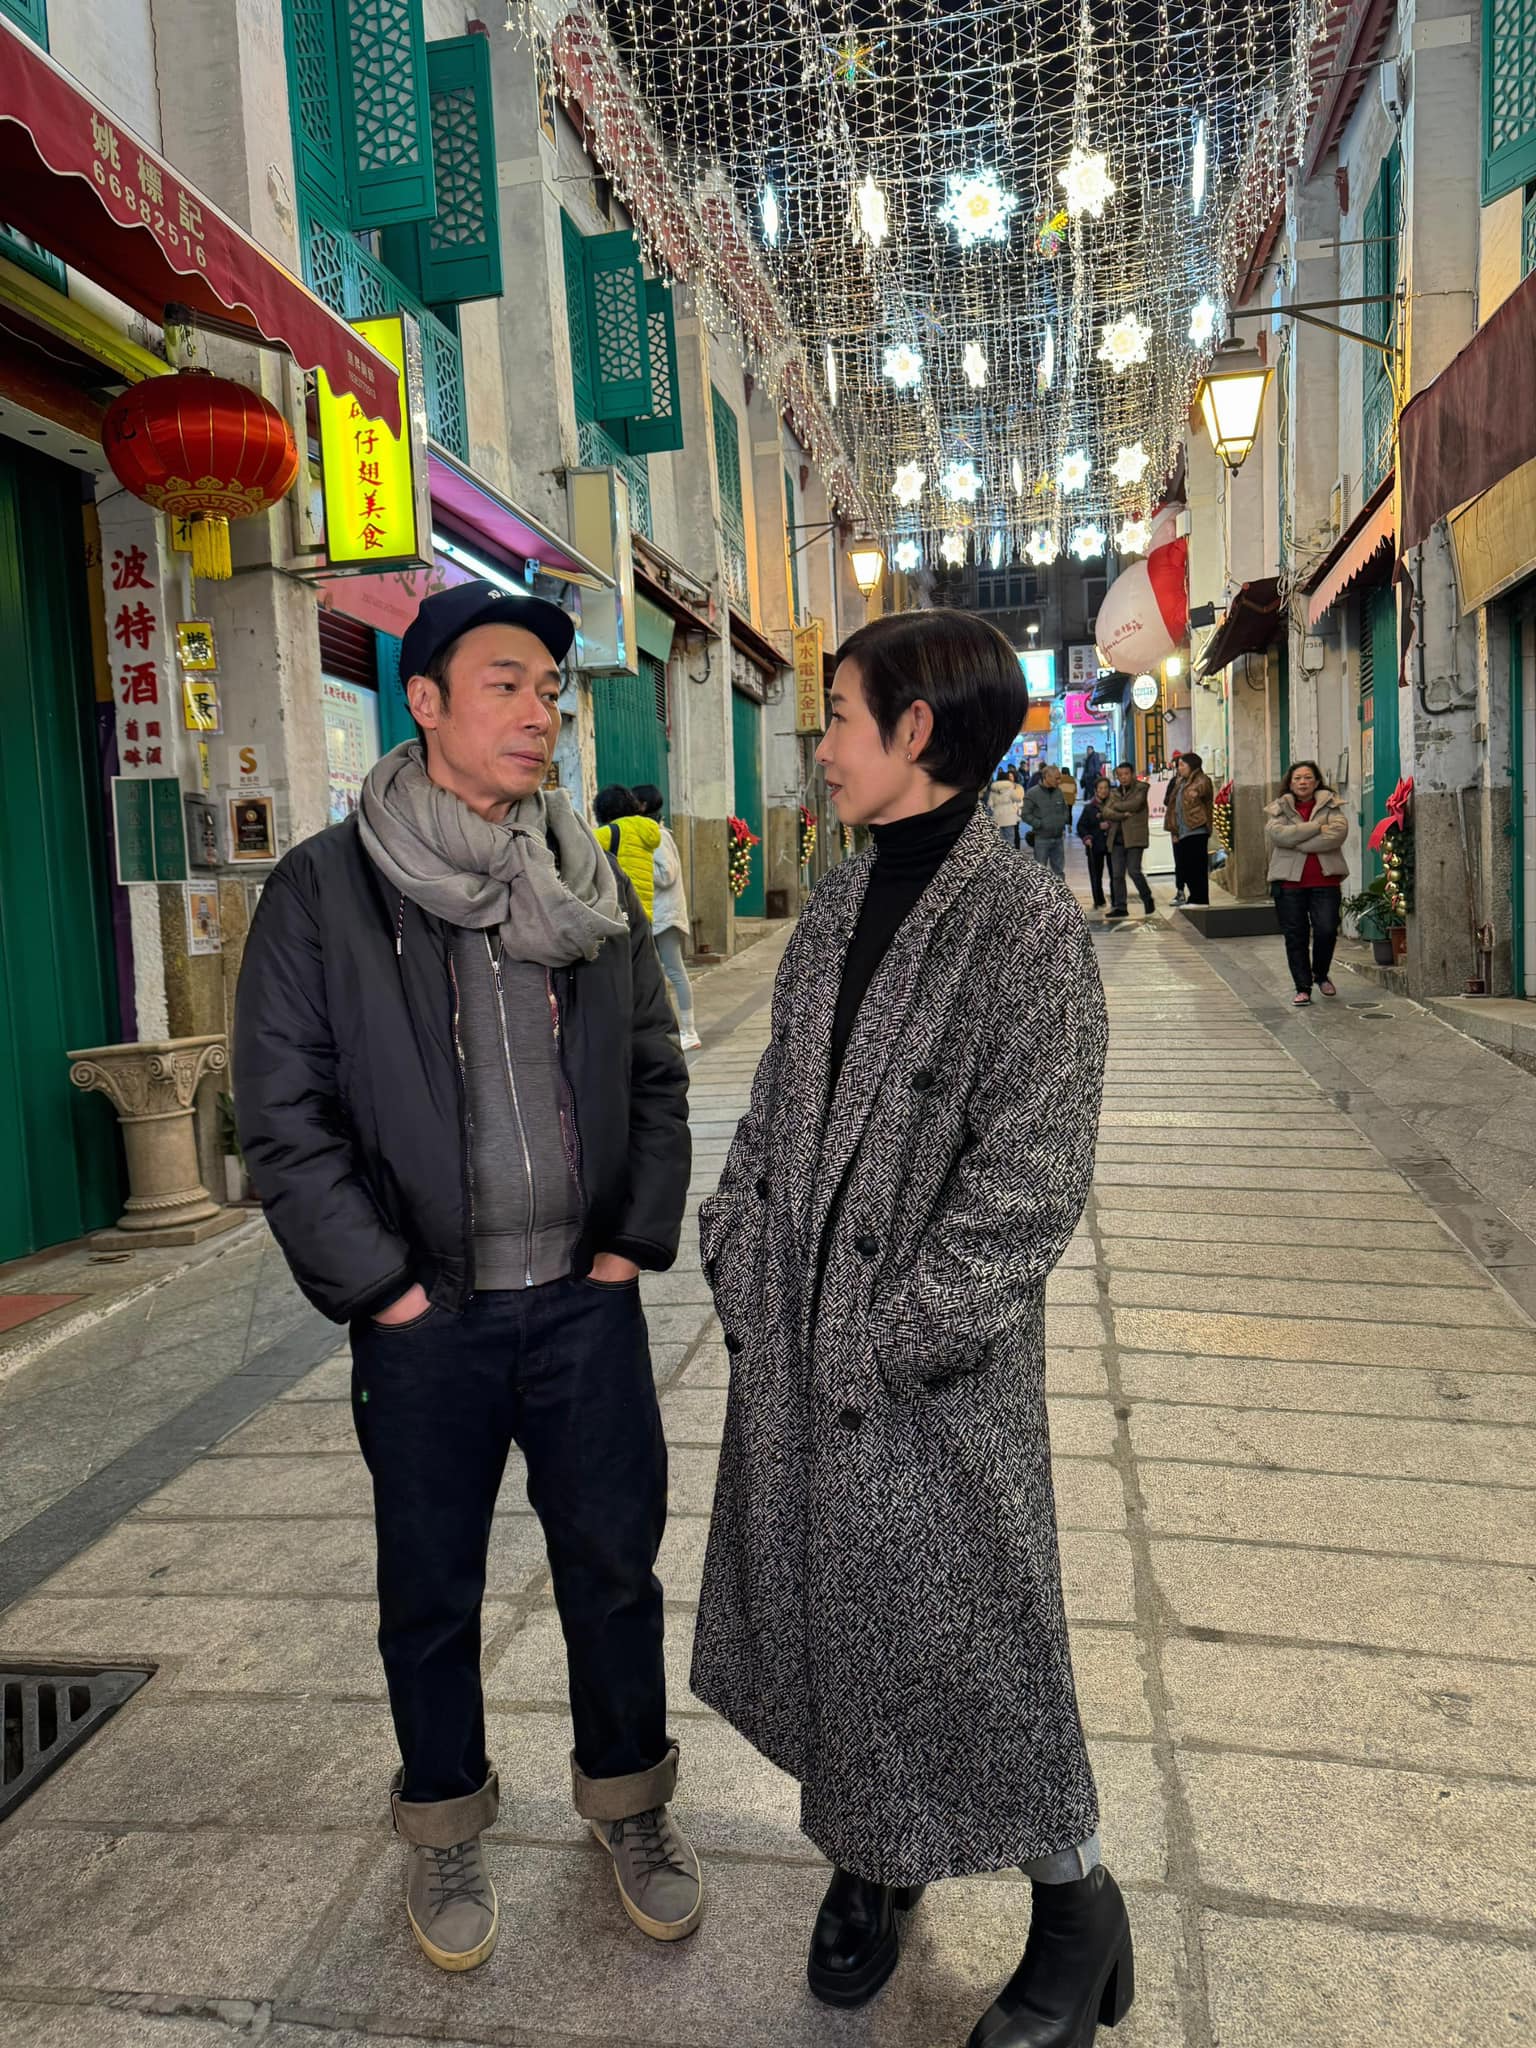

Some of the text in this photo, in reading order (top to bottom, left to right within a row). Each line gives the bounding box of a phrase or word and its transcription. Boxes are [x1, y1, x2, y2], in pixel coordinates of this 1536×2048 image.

[90, 112, 205, 241] 姚標記
[93, 160, 207, 268] 66882516
[110, 544, 159, 706] 波特酒
